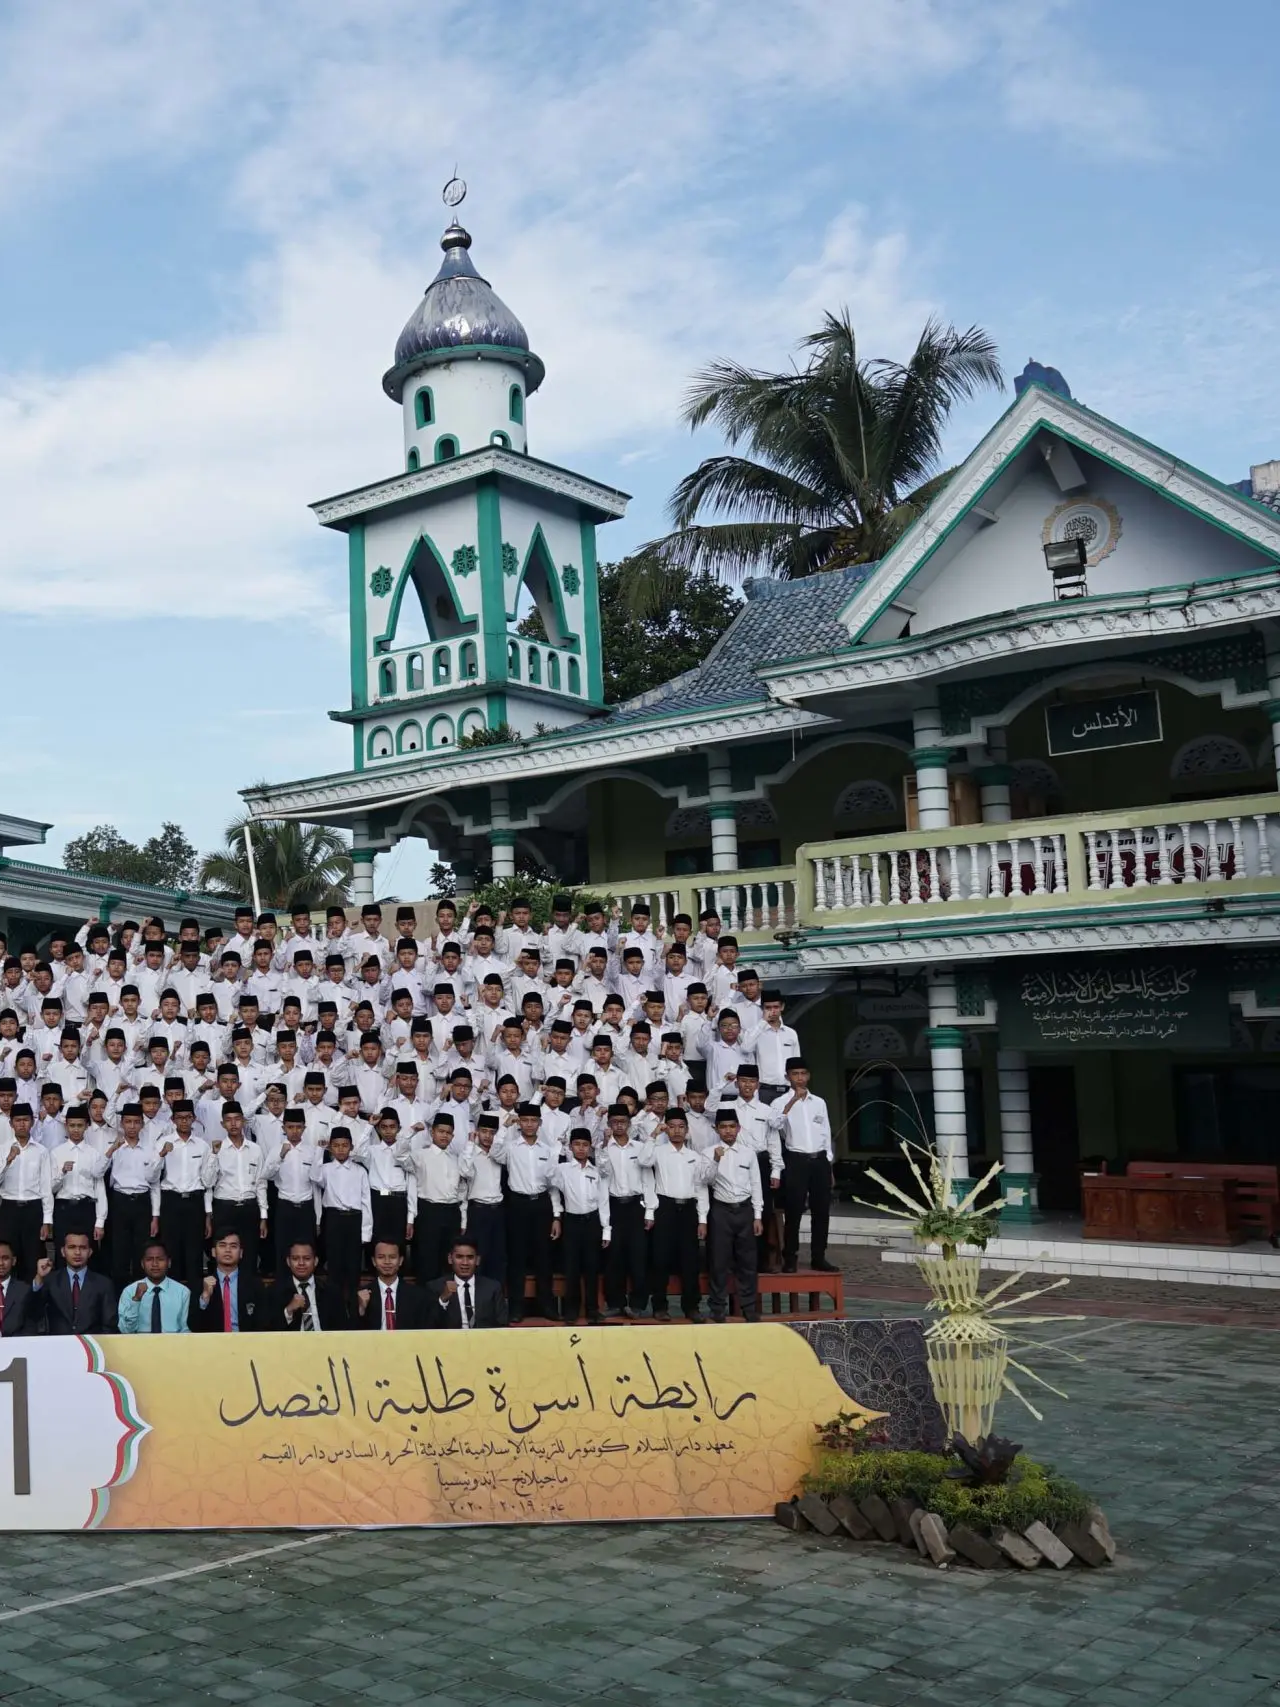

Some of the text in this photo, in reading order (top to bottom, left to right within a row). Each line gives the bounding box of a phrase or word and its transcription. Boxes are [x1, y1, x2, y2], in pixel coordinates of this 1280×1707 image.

[1072, 704, 1138, 738] الأندلس
[219, 1333, 757, 1434] رابطة أسرة طلبة الفصل
[299, 1444, 326, 1465] دار
[328, 1440, 378, 1463] السادس
[381, 1438, 418, 1465] الحرم
[530, 1438, 566, 1462] للتربية
[632, 1437, 671, 1456] السلام
[675, 1437, 701, 1457] دار
